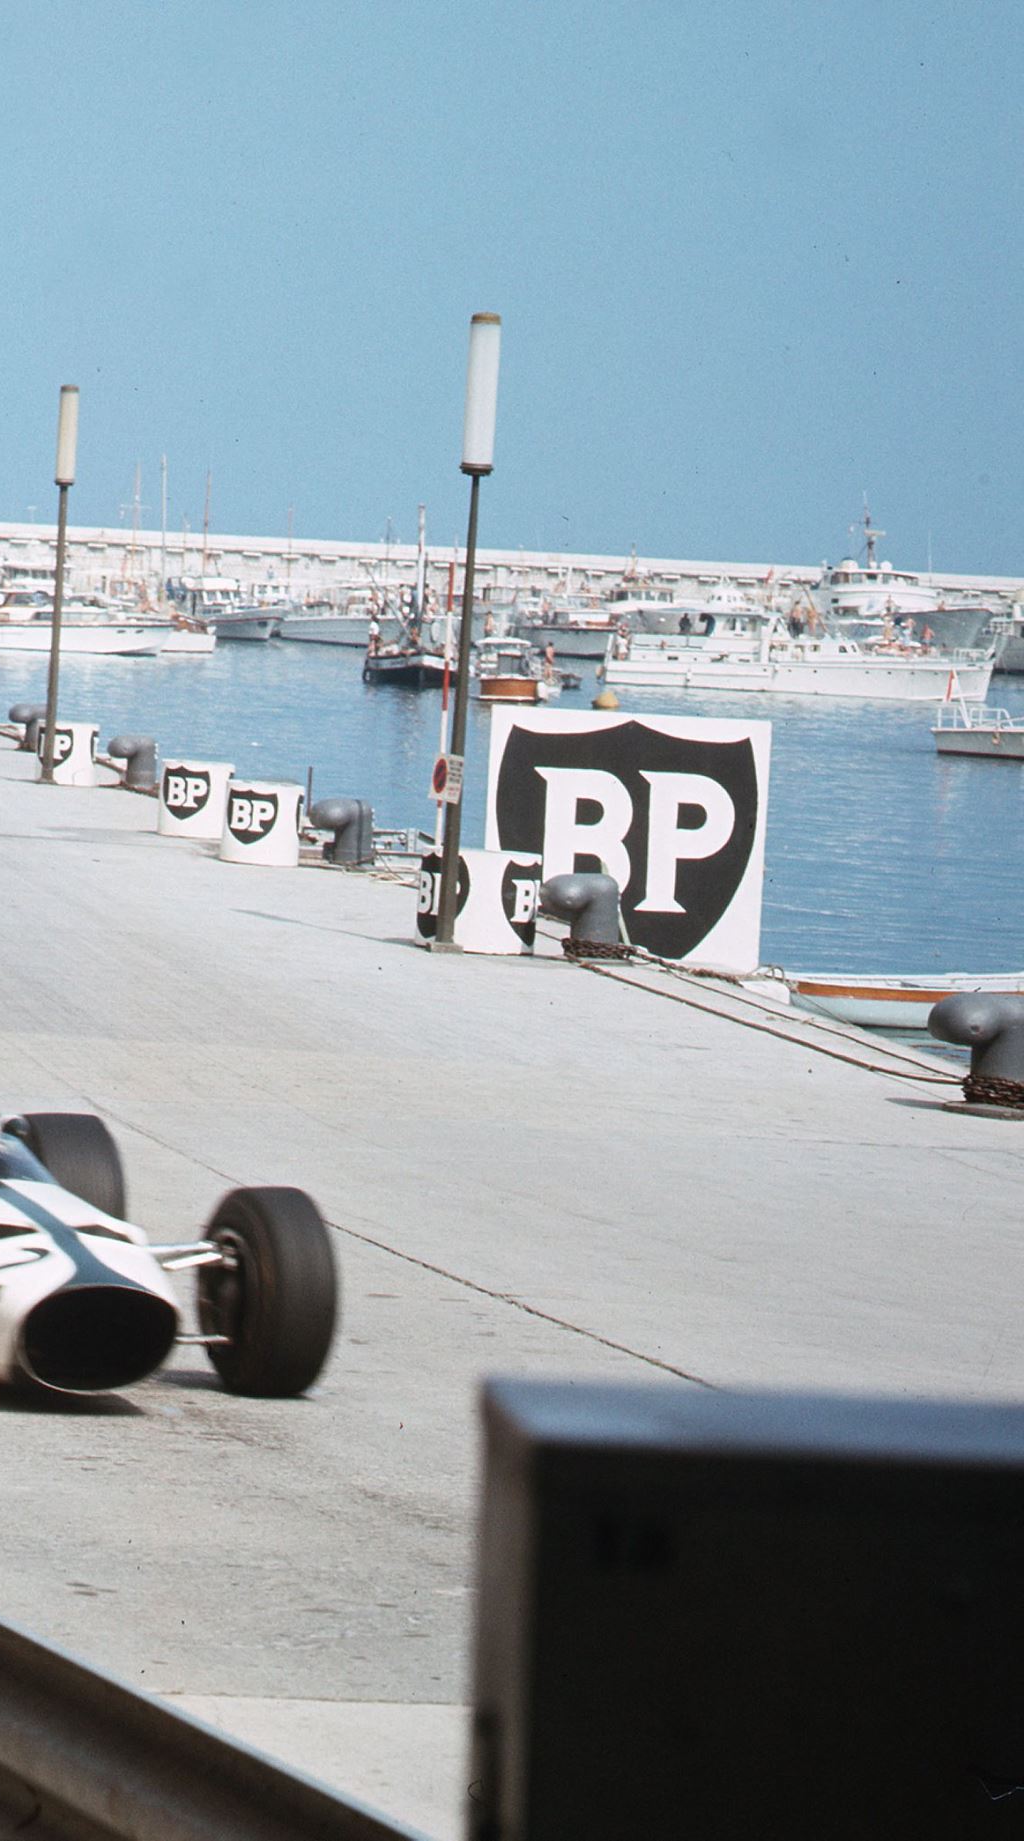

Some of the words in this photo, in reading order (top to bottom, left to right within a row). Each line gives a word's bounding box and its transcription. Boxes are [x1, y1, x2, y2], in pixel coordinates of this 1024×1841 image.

[167, 776, 208, 808] BP
[230, 798, 275, 834] BP
[534, 766, 736, 914] BP
